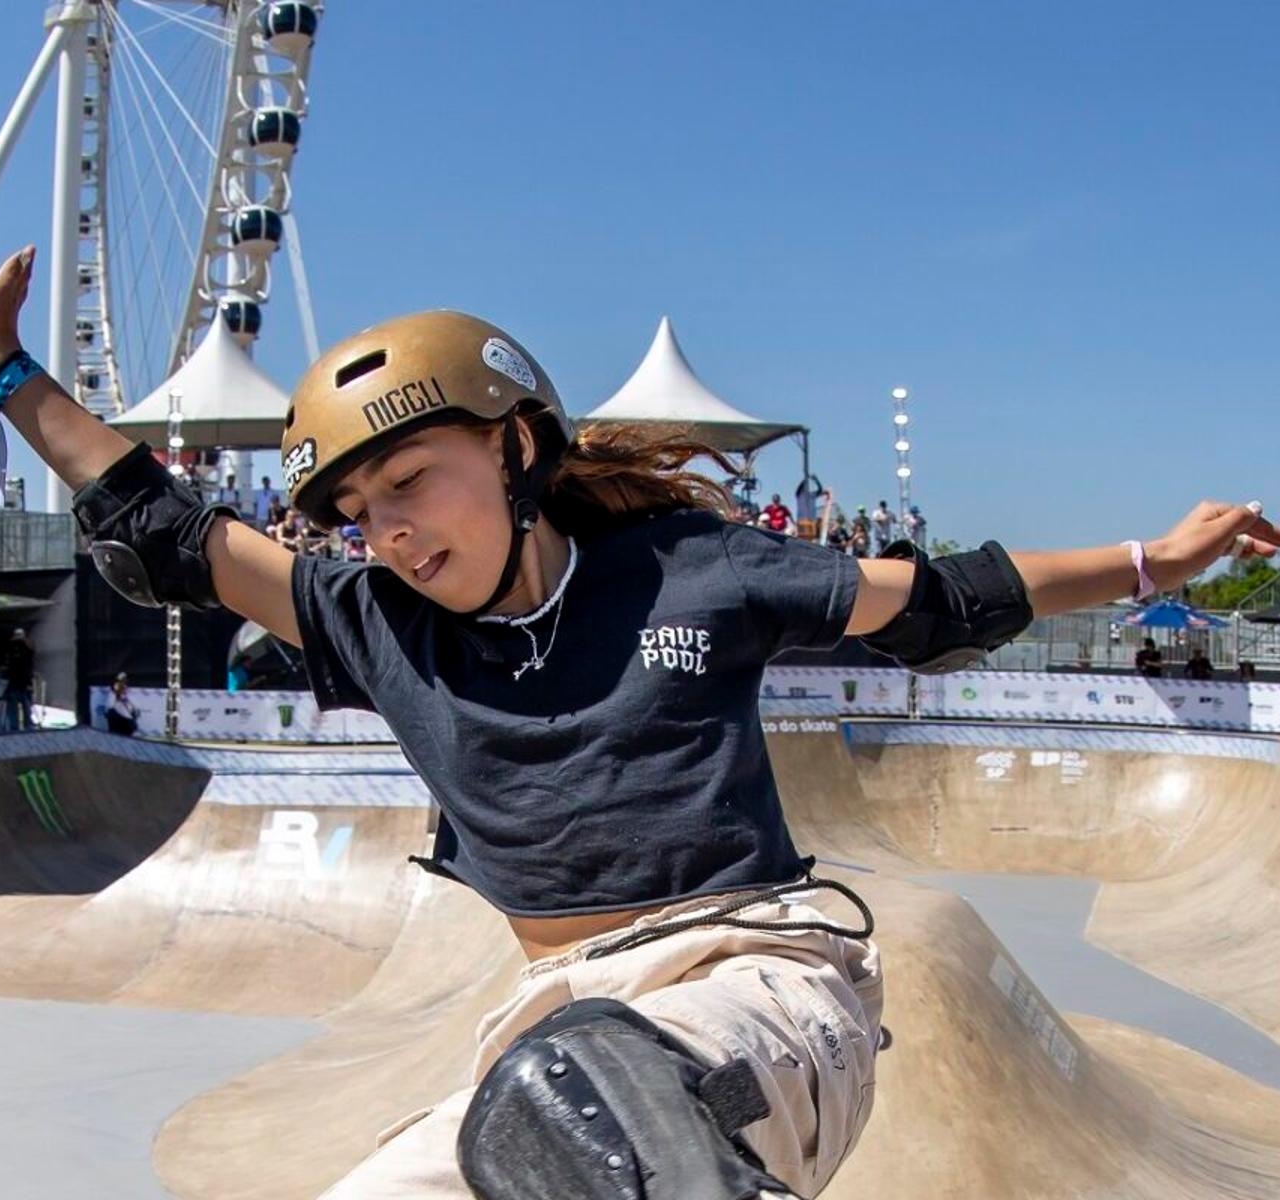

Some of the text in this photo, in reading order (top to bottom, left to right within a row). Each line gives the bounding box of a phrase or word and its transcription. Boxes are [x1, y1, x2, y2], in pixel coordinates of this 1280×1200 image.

[362, 376, 447, 433] NIGGLI
[780, 719, 797, 733] do
[799, 719, 838, 733] skate
